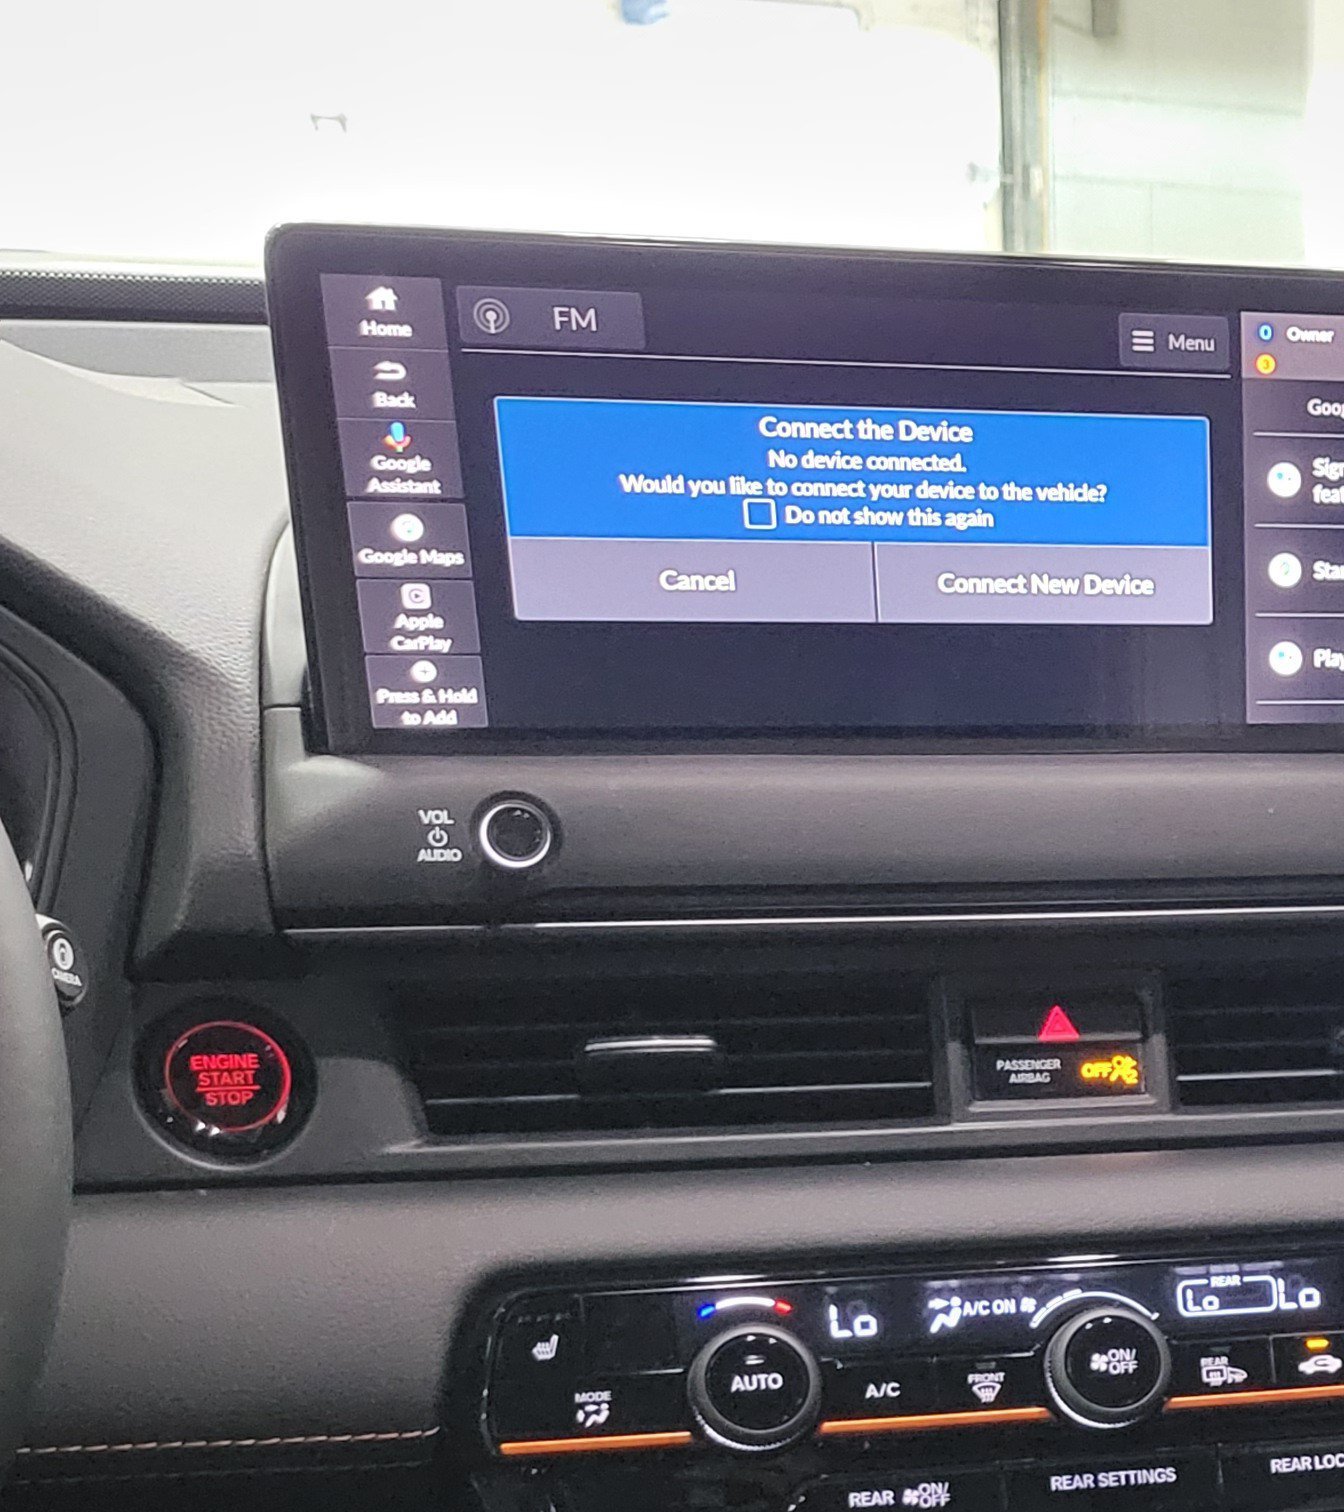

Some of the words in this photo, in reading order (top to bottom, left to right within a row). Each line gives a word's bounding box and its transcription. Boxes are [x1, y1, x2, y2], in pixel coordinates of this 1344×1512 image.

[553, 306, 598, 332] FM
[360, 321, 412, 338] Home
[1286, 326, 1334, 344] Owner
[1168, 333, 1215, 353] Menu
[374, 392, 415, 409] Back
[759, 416, 854, 439] Connect
[857, 419, 894, 441] the
[899, 420, 973, 443] Device
[371, 455, 431, 474] Google
[768, 449, 798, 469] No
[801, 450, 863, 470] device
[866, 453, 967, 473] connected.
[367, 477, 441, 494] Assistant
[619, 474, 685, 494] Would
[688, 478, 726, 497] you
[730, 476, 762, 495] like
[766, 479, 788, 496] to
[791, 480, 865, 498] connect
[869, 482, 913, 501] your
[916, 480, 975, 500] device
[979, 482, 999, 501] to
[1002, 482, 1033, 501] the
[1036, 483, 1107, 503] vehicle?
[785, 505, 815, 525] Do
[818, 507, 851, 526] not
[854, 507, 904, 526] show
[907, 507, 942, 527] this
[945, 509, 994, 531] again
[359, 549, 414, 567] Google
[416, 550, 465, 568] Maps
[659, 569, 736, 591] Cancel
[937, 573, 1027, 595] Connect
[1030, 573, 1079, 595] New
[1083, 574, 1154, 596] Device
[395, 614, 443, 632] Apple
[391, 636, 452, 653] CarPlay
[376, 687, 419, 704] Press
[438, 687, 478, 704] Hold
[402, 710, 419, 725] to
[421, 709, 457, 725] Add
[417, 809, 455, 825] VOL
[416, 848, 463, 863] AUDIO
[189, 1053, 260, 1071] ENGINE
[996, 1058, 1062, 1071] PASSENGER
[1080, 1061, 1112, 1078] OFF
[197, 1070, 256, 1087] START
[1008, 1072, 1051, 1084] AIRBAG
[204, 1091, 254, 1107] STOP
[1210, 1275, 1241, 1288] REAR
[1186, 1288, 1220, 1311] Lo
[1277, 1277, 1321, 1309] Lo
[962, 1300, 991, 1317] A/C
[992, 1298, 1016, 1315] ON
[829, 1304, 878, 1339] Lo
[1107, 1348, 1137, 1362] ON/
[1201, 1356, 1228, 1367] REAR
[1108, 1361, 1139, 1375] OFF
[730, 1373, 784, 1393] AUTO
[967, 1372, 1006, 1384] FRONT
[574, 1390, 613, 1404] MODE
[865, 1382, 901, 1399] A/C
[1270, 1455, 1311, 1474] REAR
[1050, 1473, 1095, 1491] REAR
[1097, 1467, 1177, 1488] SETTINGS
[848, 1489, 895, 1508] REAR
[919, 1494, 951, 1509] OFF
